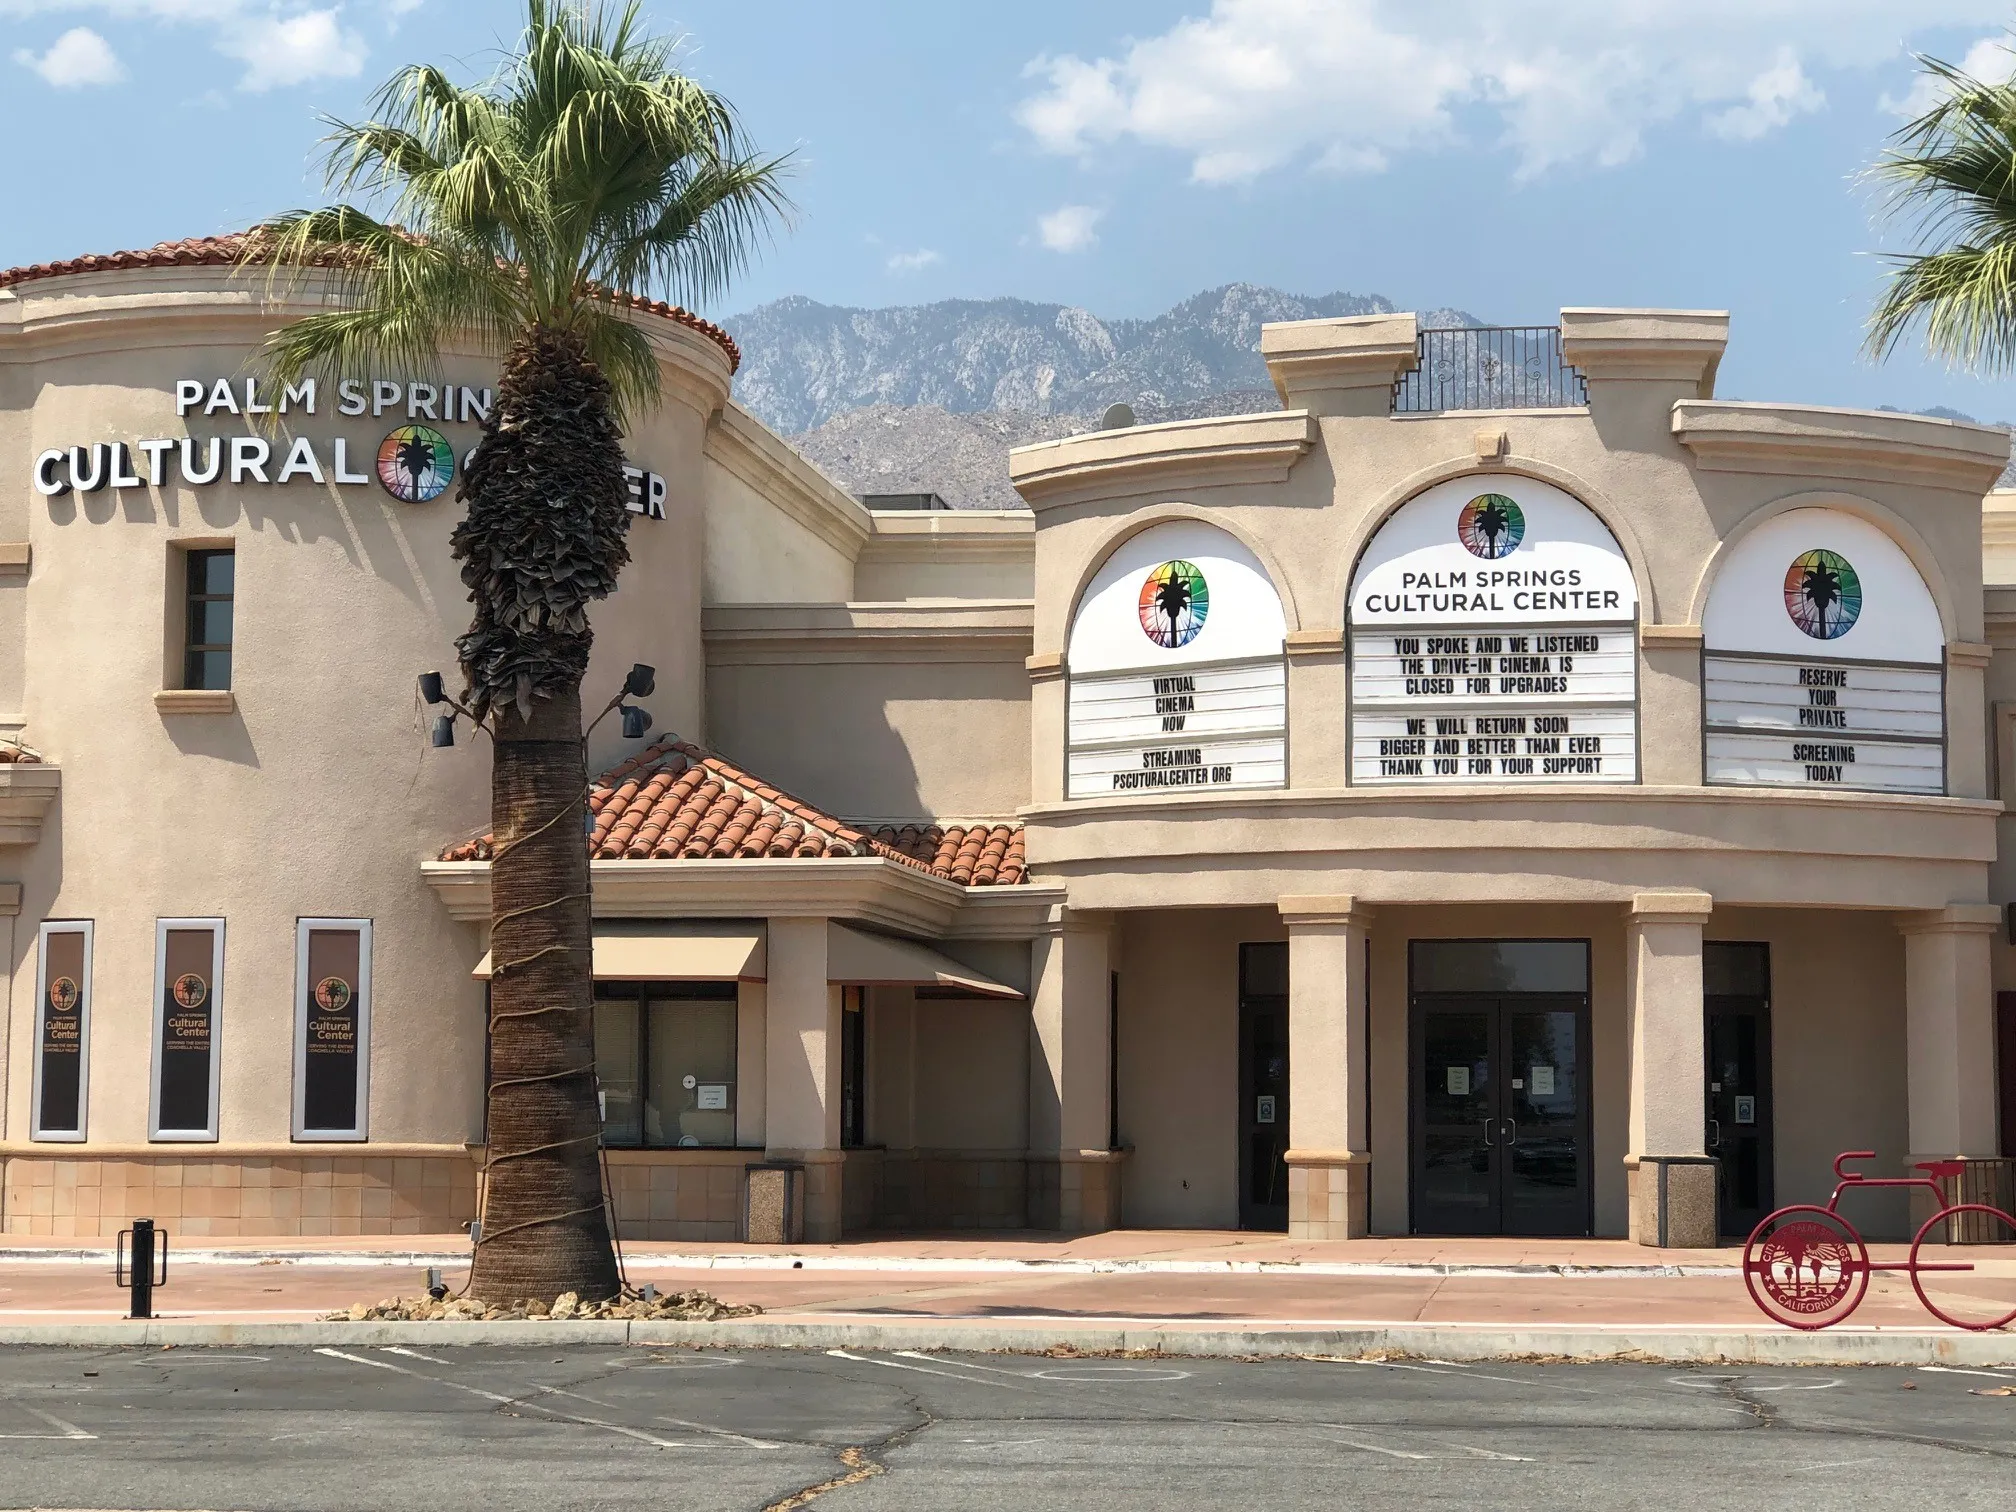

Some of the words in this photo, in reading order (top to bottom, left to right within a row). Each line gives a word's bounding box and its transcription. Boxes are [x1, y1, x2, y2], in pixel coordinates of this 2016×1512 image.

[176, 377, 316, 416] PALM
[338, 378, 493, 422] SPRIN
[33, 436, 370, 496] CULTURAL
[1402, 571, 1467, 589] PALM
[1476, 569, 1581, 588] SPRINGS
[1365, 593, 1504, 613] CULTURAL
[1513, 590, 1620, 611] CENTER
[1394, 638, 1420, 655] YOU
[1427, 637, 1469, 654] SPOKE
[1475, 637, 1502, 654] AND
[1509, 636, 1529, 653] WE
[1536, 635, 1599, 653] LISTENED
[1401, 658, 1424, 675] THE
[1432, 657, 1492, 675] DRIVE-IN
[1499, 656, 1551, 674] CINEMA
[1559, 656, 1573, 673] IS
[1153, 676, 1195, 694] VIRTUAL
[1405, 678, 1454, 695] CLOSED
[1466, 677, 1491, 694] FOR
[1500, 676, 1568, 694] UPGRADES
[1800, 669, 1847, 687] RESERVE
[1156, 696, 1194, 713] CINEMA
[1809, 689, 1837, 706] YOUR
[1162, 716, 1185, 731] NOW
[1406, 718, 1426, 735] WE
[1436, 718, 1468, 735] WILL
[1476, 717, 1526, 734] RETURN
[1533, 716, 1569, 734] SOON
[1800, 709, 1846, 727] PRIVATE
[1380, 739, 1426, 756] BIGGER
[1433, 738, 1460, 755] AND
[1467, 737, 1516, 755] BETTER
[1525, 737, 1560, 754] THAN
[1569, 736, 1601, 754] EVER
[1793, 744, 1855, 762] SCREENING
[1142, 748, 1202, 768] STREAMING
[1380, 759, 1423, 776] THANK
[1433, 758, 1459, 775] YOU
[1468, 758, 1493, 775] FOR
[1500, 757, 1534, 775] YOUR
[1542, 756, 1603, 774] SUPPORT
[1113, 768, 1208, 789] PSCUTURALCENTER
[1211, 766, 1232, 783] ORG
[1805, 764, 1843, 782] TODAY
[45, 1021, 77, 1030] Cultural
[168, 1018, 207, 1027] Cultural
[309, 1021, 351, 1030] Cultural
[51, 1030, 79, 1039] Center
[176, 1028, 209, 1036] Center
[317, 1030, 354, 1040] Center
[1762, 1242, 1776, 1262] CITY
[1777, 1294, 1839, 1312] CALIFORNIA
